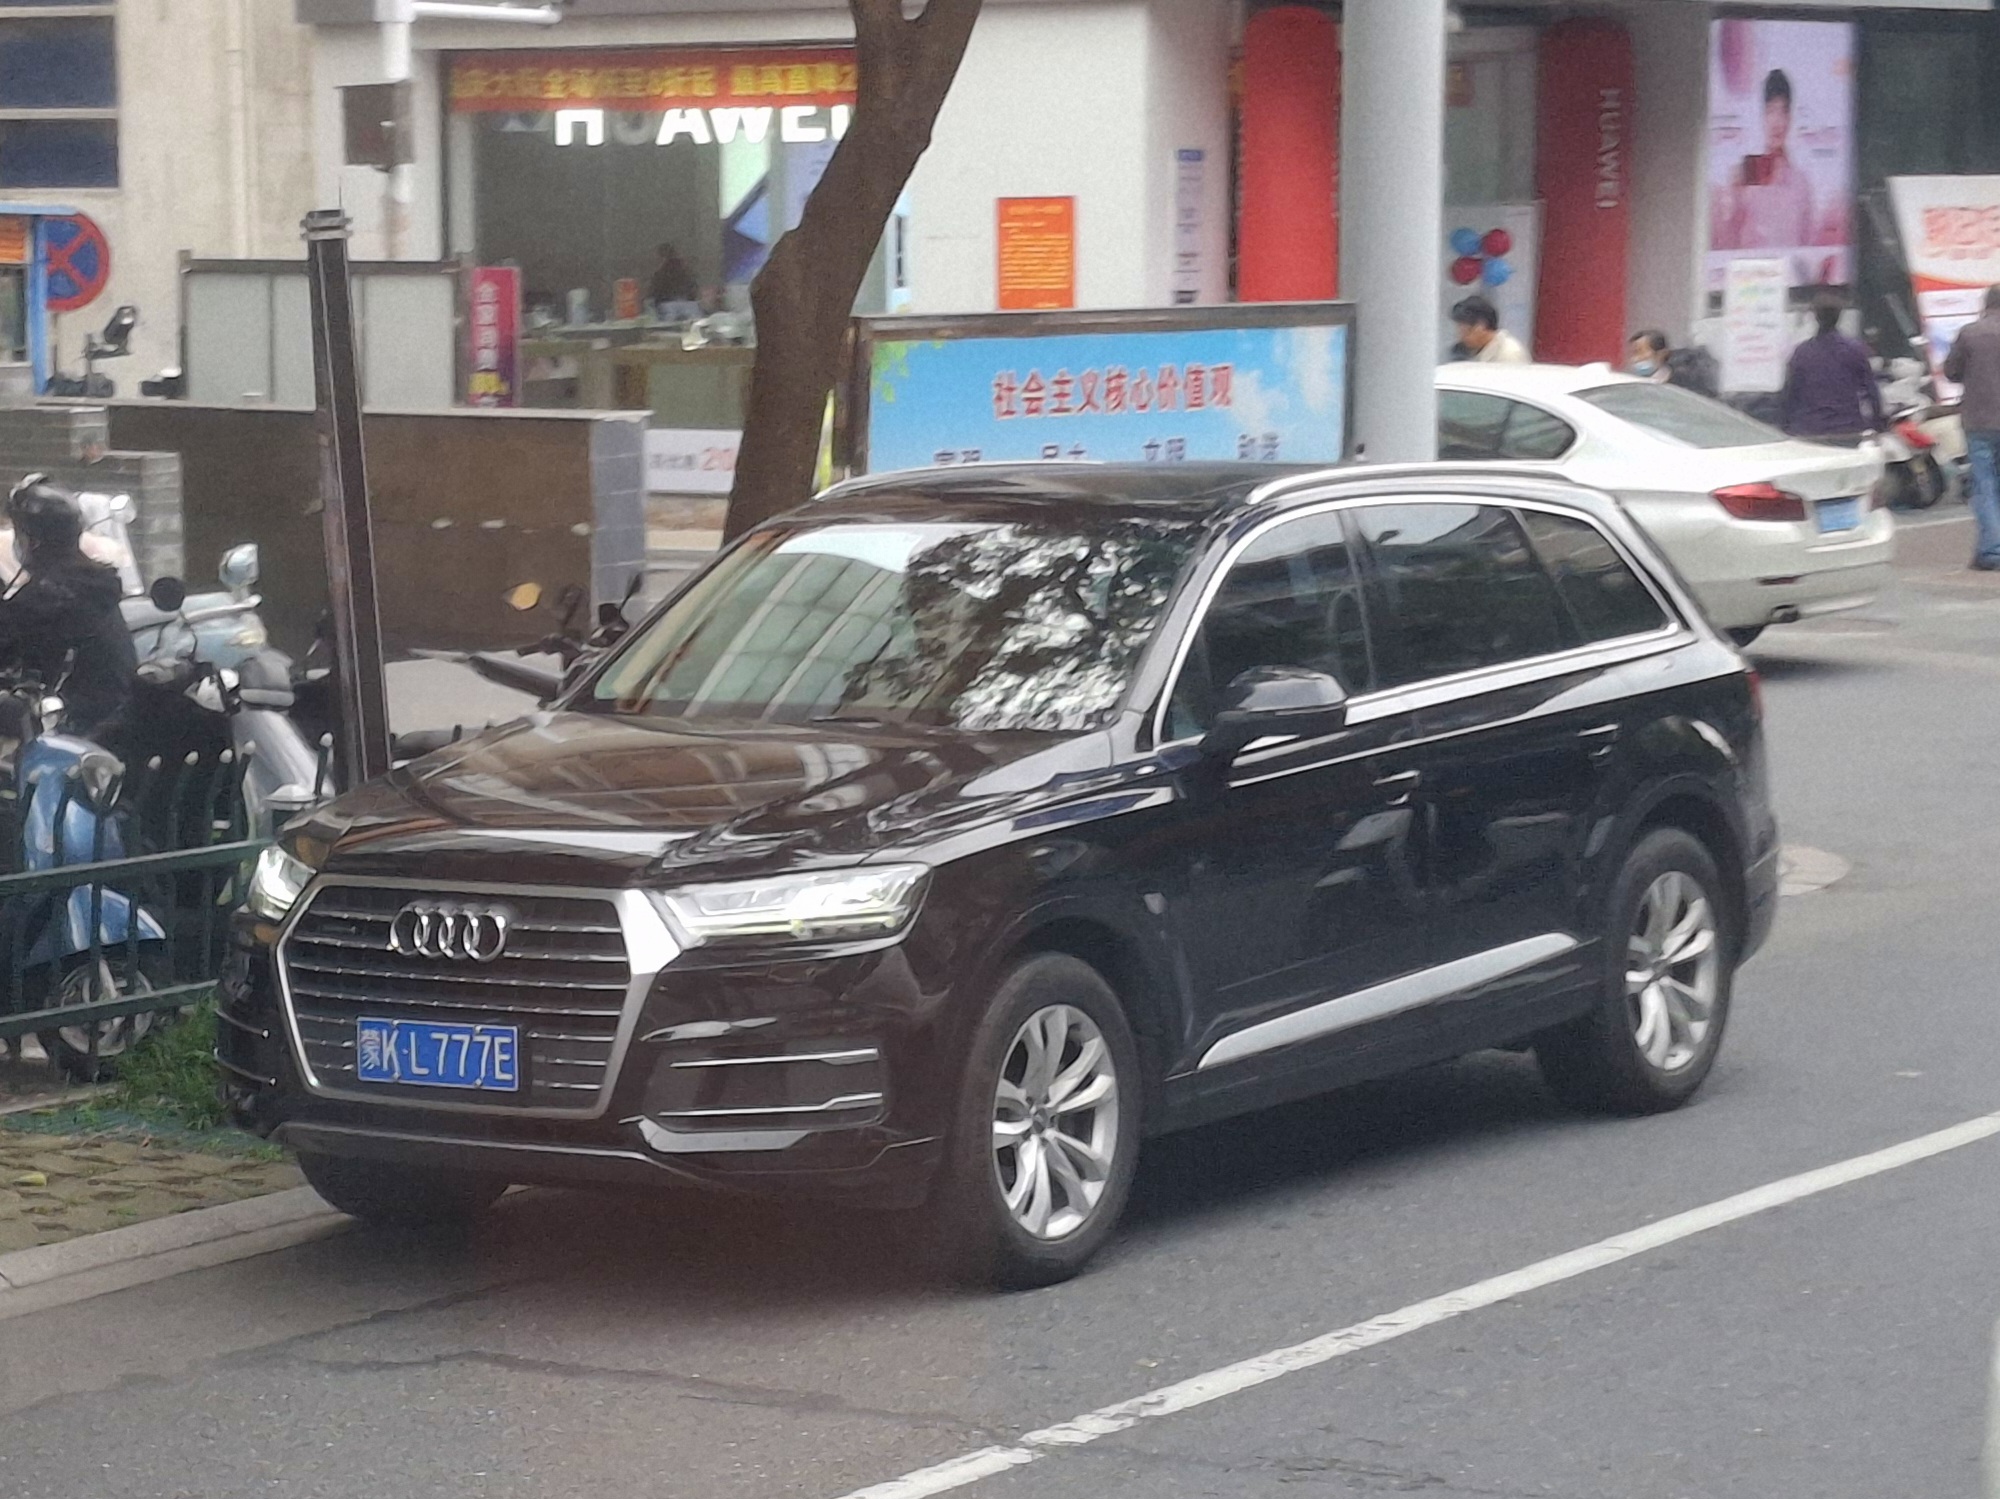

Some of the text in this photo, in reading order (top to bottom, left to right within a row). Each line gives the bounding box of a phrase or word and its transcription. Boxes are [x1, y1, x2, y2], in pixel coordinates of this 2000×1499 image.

[555, 106, 850, 146] HUAWEI
[1596, 89, 1623, 209] HUAWEI
[993, 364, 1233, 420] 社会主义核心价值观
